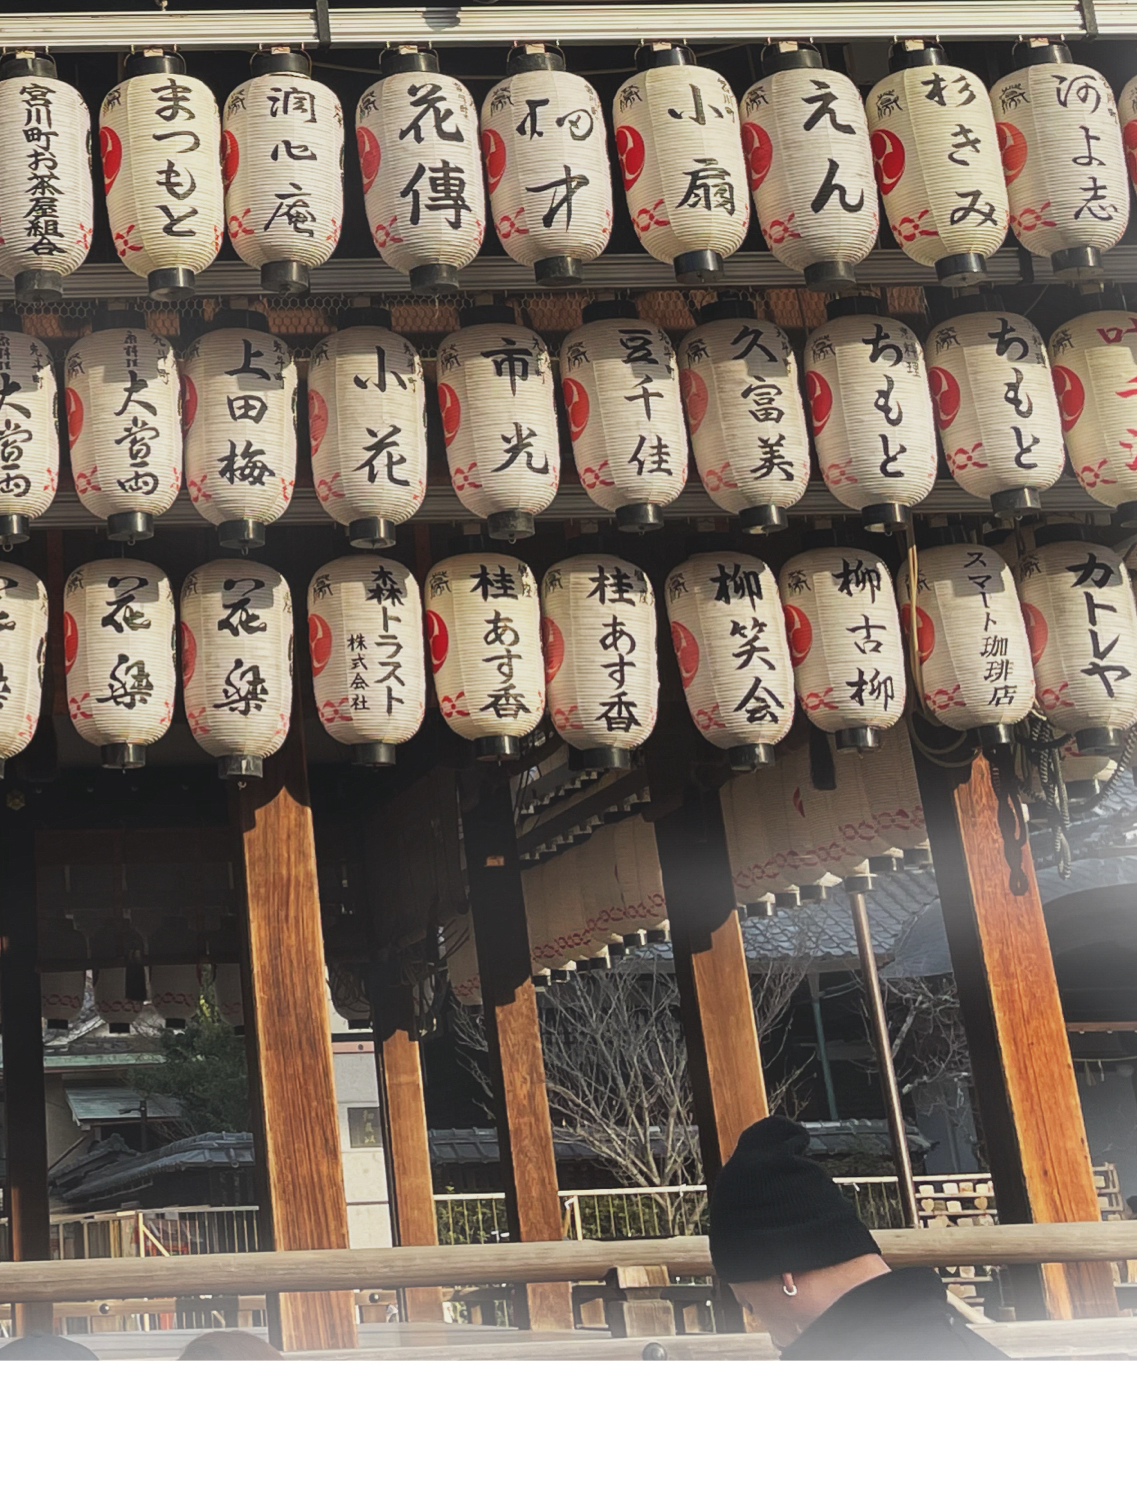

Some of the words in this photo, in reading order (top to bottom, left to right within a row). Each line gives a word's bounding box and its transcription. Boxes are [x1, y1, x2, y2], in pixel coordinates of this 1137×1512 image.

[19, 83, 67, 256] 宮川町お茶屋組合
[151, 78, 201, 237] まつもと
[667, 83, 736, 217] 小扇
[802, 79, 864, 214] えん
[921, 72, 999, 227] 杉きみ
[217, 338, 276, 487] 上田梅
[352, 345, 412, 487] 小花
[480, 337, 551, 477] 市光
[618, 328, 674, 477] 豆千佳
[731, 325, 794, 482] 久富美
[862, 323, 907, 478] ちもと
[987, 317, 1042, 469] ちもと
[346, 633, 370, 711] 株式会社
[366, 565, 405, 717] 森トラスト
[470, 564, 532, 719] 桂あす香
[587, 565, 643, 733] 桂あす香
[963, 551, 1017, 707] スマート珈琲店
[1066, 552, 1132, 698] カトレヤ
